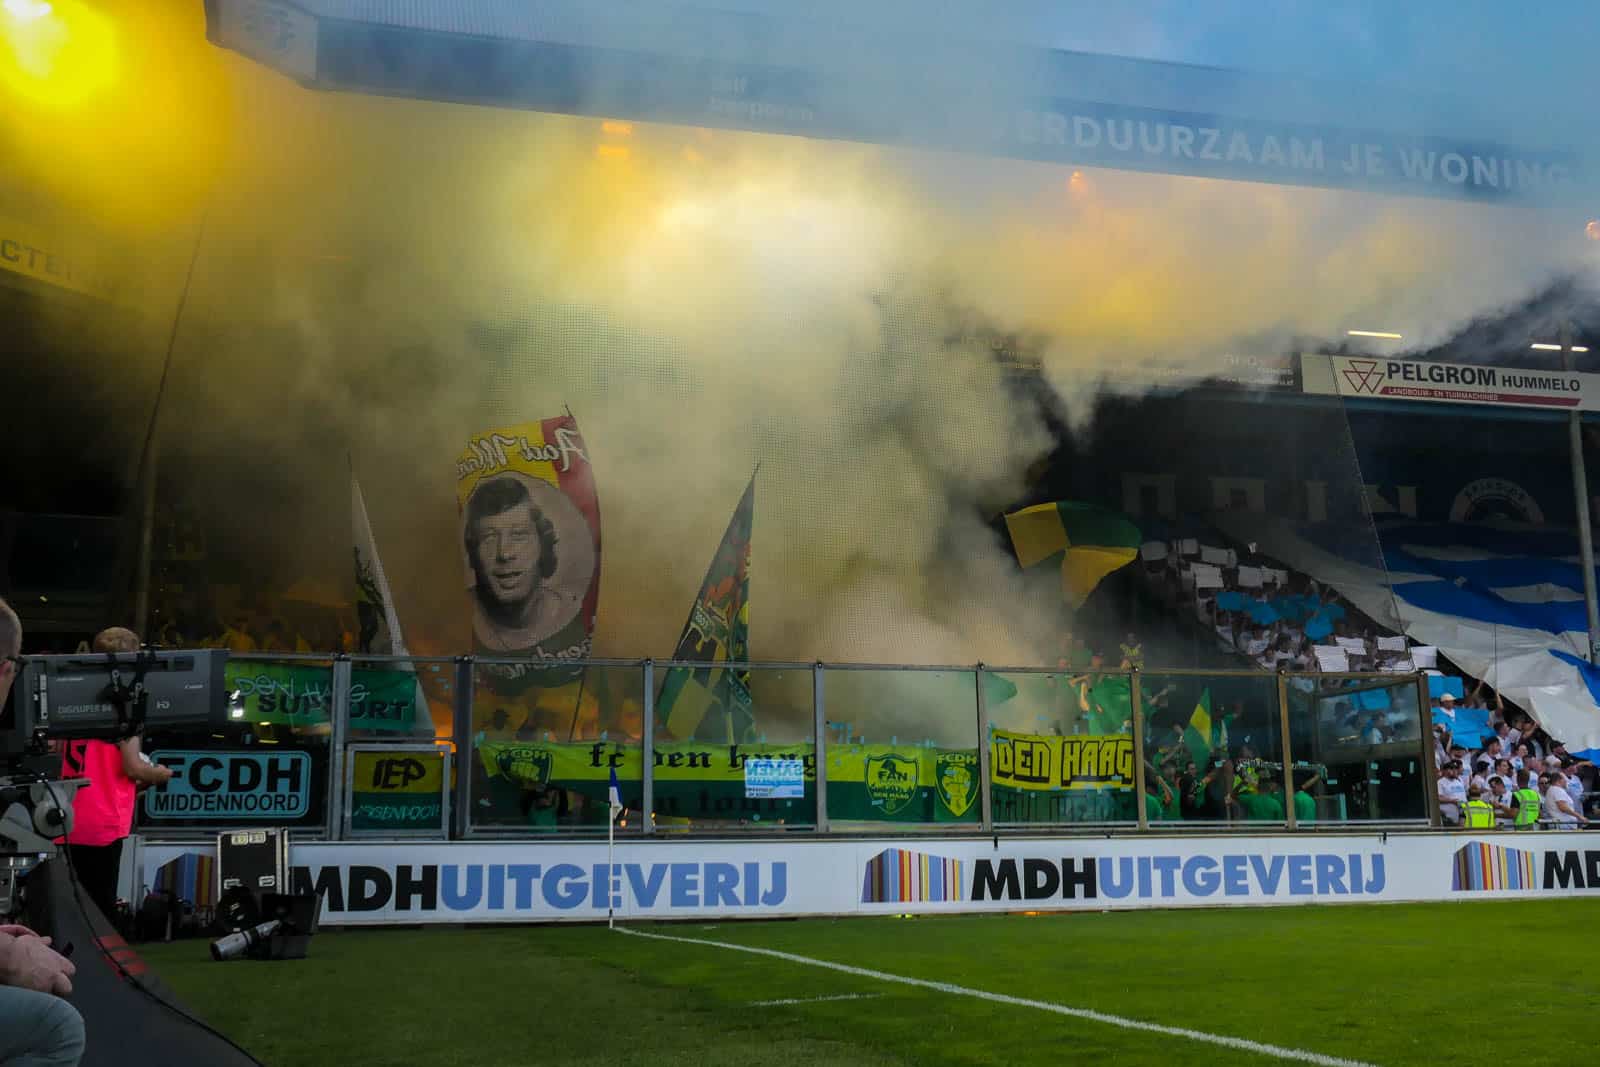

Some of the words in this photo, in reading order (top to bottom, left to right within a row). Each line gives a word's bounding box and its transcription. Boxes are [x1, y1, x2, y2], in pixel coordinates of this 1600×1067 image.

[1012, 109, 1325, 170] ERDUURZAAM
[1341, 143, 1386, 177] JE
[1387, 361, 1497, 387] PELGROM
[1502, 374, 1581, 392] HUMMELO
[235, 675, 296, 699] DEN
[301, 680, 371, 703] HAG
[937, 753, 977, 766] FCDH
[996, 736, 1051, 783] DEN
[1061, 739, 1134, 786] HAAG
[155, 757, 302, 793] FCDH
[878, 770, 908, 782] FAN
[154, 794, 300, 812] MIDDENNOORD
